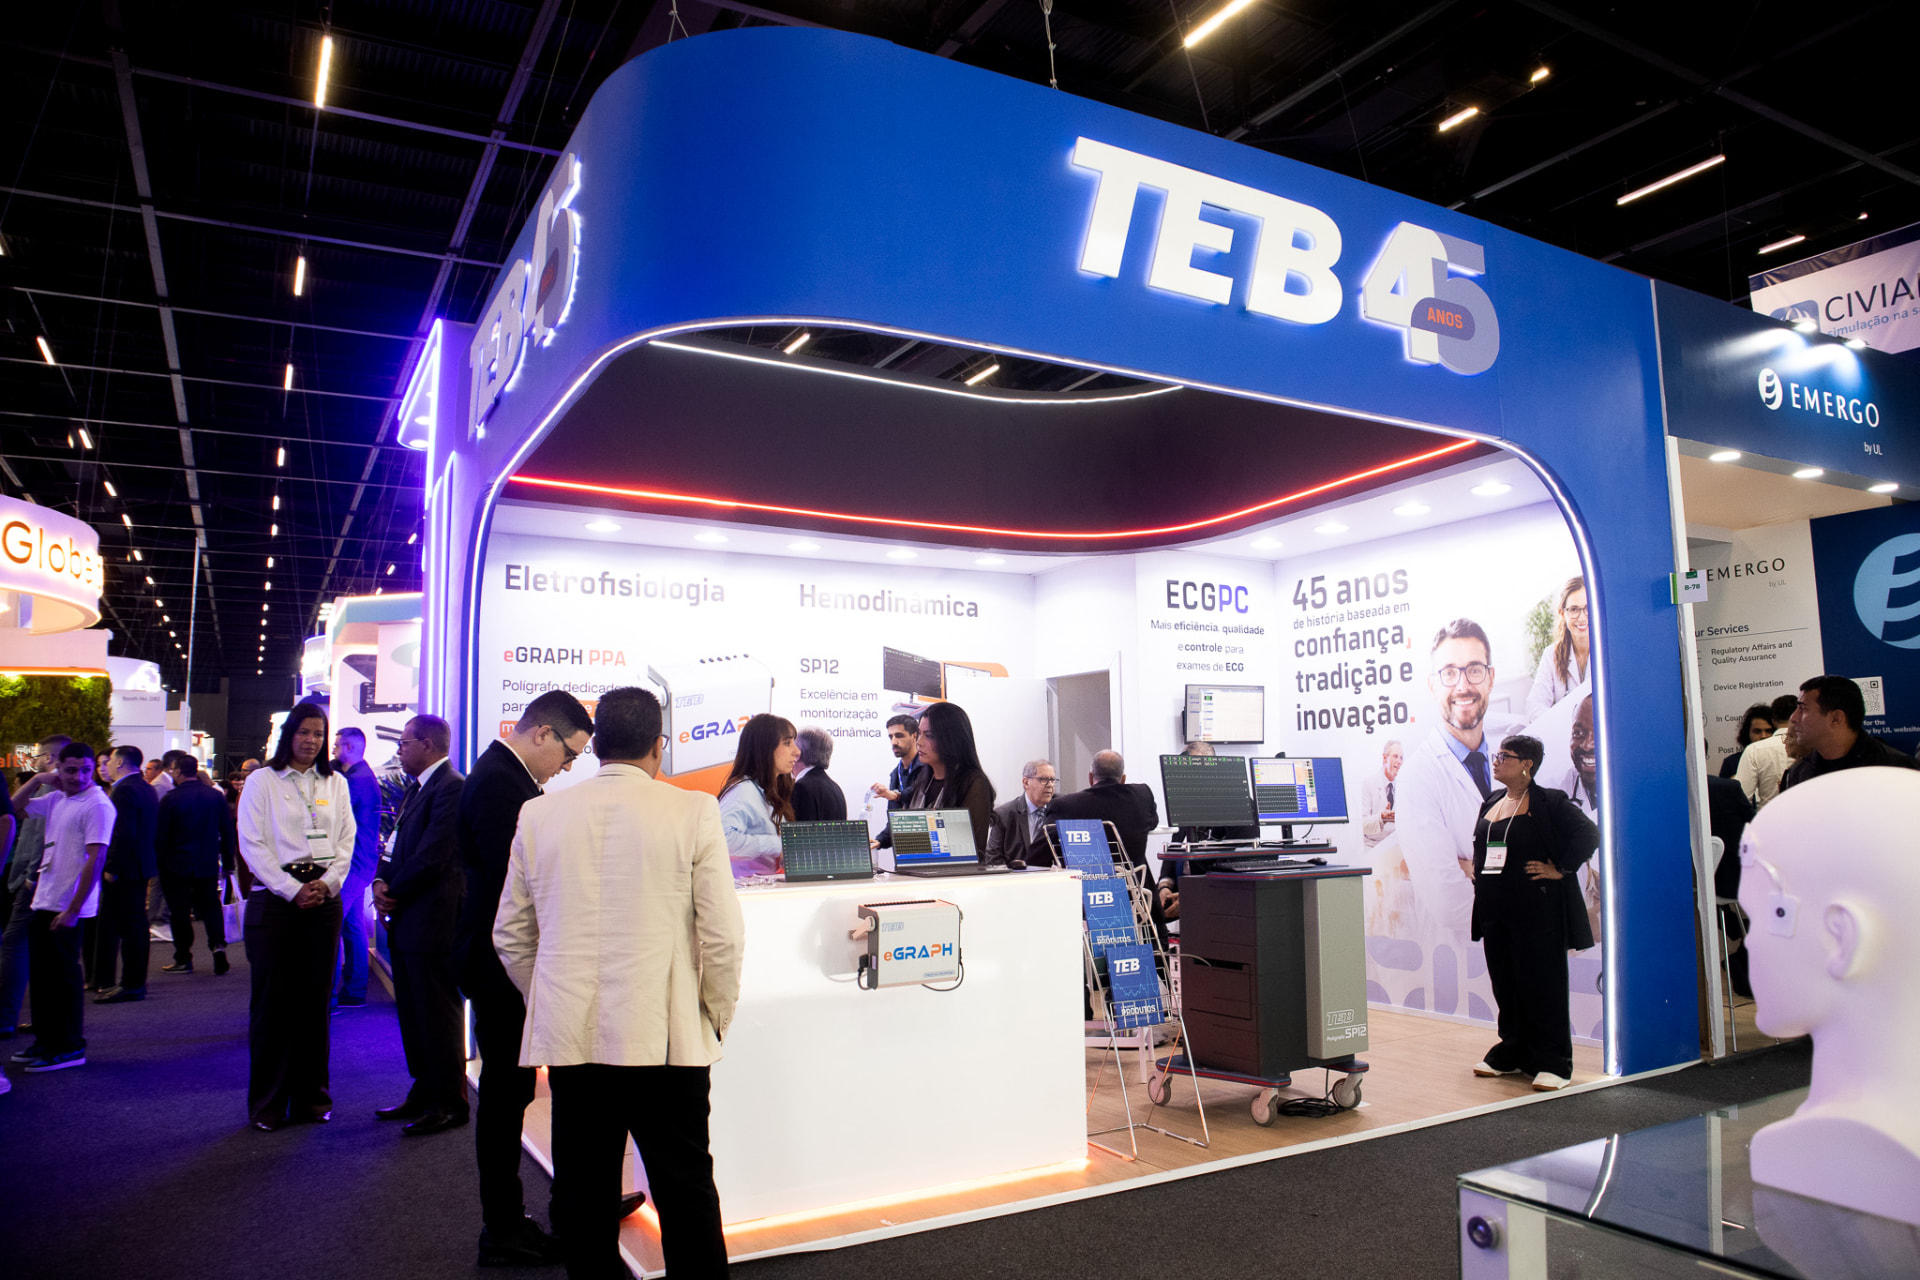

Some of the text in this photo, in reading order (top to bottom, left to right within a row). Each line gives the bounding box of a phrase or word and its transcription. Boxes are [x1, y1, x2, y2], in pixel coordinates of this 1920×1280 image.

[1072, 136, 1500, 375] TEB 45
[1825, 272, 1920, 322] CIVIA
[1427, 307, 1463, 329] ANOS
[1828, 315, 1889, 337] simulação
[1893, 310, 1908, 320] na
[1790, 382, 1880, 428] EMERGO
[1864, 442, 1883, 456] by UL
[1707, 557, 1786, 582] EMERGO
[505, 564, 725, 607] Eletrofisiologia
[1292, 568, 1408, 612] 45 anos
[800, 583, 979, 618] Hemodinâmica
[1166, 579, 1249, 614] ECGPC
[1293, 602, 1410, 630] de história baseada em
[1150, 619, 1172, 630] Mais
[1222, 625, 1264, 636] qualidade
[1695, 624, 1750, 638] ur Services
[1184, 643, 1222, 652] controle
[1225, 646, 1244, 654] para
[1294, 624, 1412, 658] confiança,
[1712, 645, 1750, 656] Regulatory
[1752, 643, 1776, 652] Affairs
[504, 646, 626, 667] eGRAPH PPA
[1712, 653, 1776, 666] Quality Assurance
[800, 658, 840, 674] SP12
[1176, 662, 1244, 672] exames de ECG
[1296, 659, 1413, 695] tradição e
[1714, 680, 1784, 692] Device Registration
[502, 680, 621, 694] Polígrafo dedicad
[800, 688, 878, 700] Excelência em
[800, 708, 878, 722] monitorização
[1296, 696, 1416, 734] inovação.
[679, 715, 756, 743] eGRAP
[826, 726, 882, 738] odinâmica
[1066, 830, 1091, 842] TEB
[1087, 892, 1114, 905] TEB
[884, 943, 952, 962] eGRAPH
[1114, 958, 1140, 974] TEB
[1345, 1026, 1366, 1039] SP12
